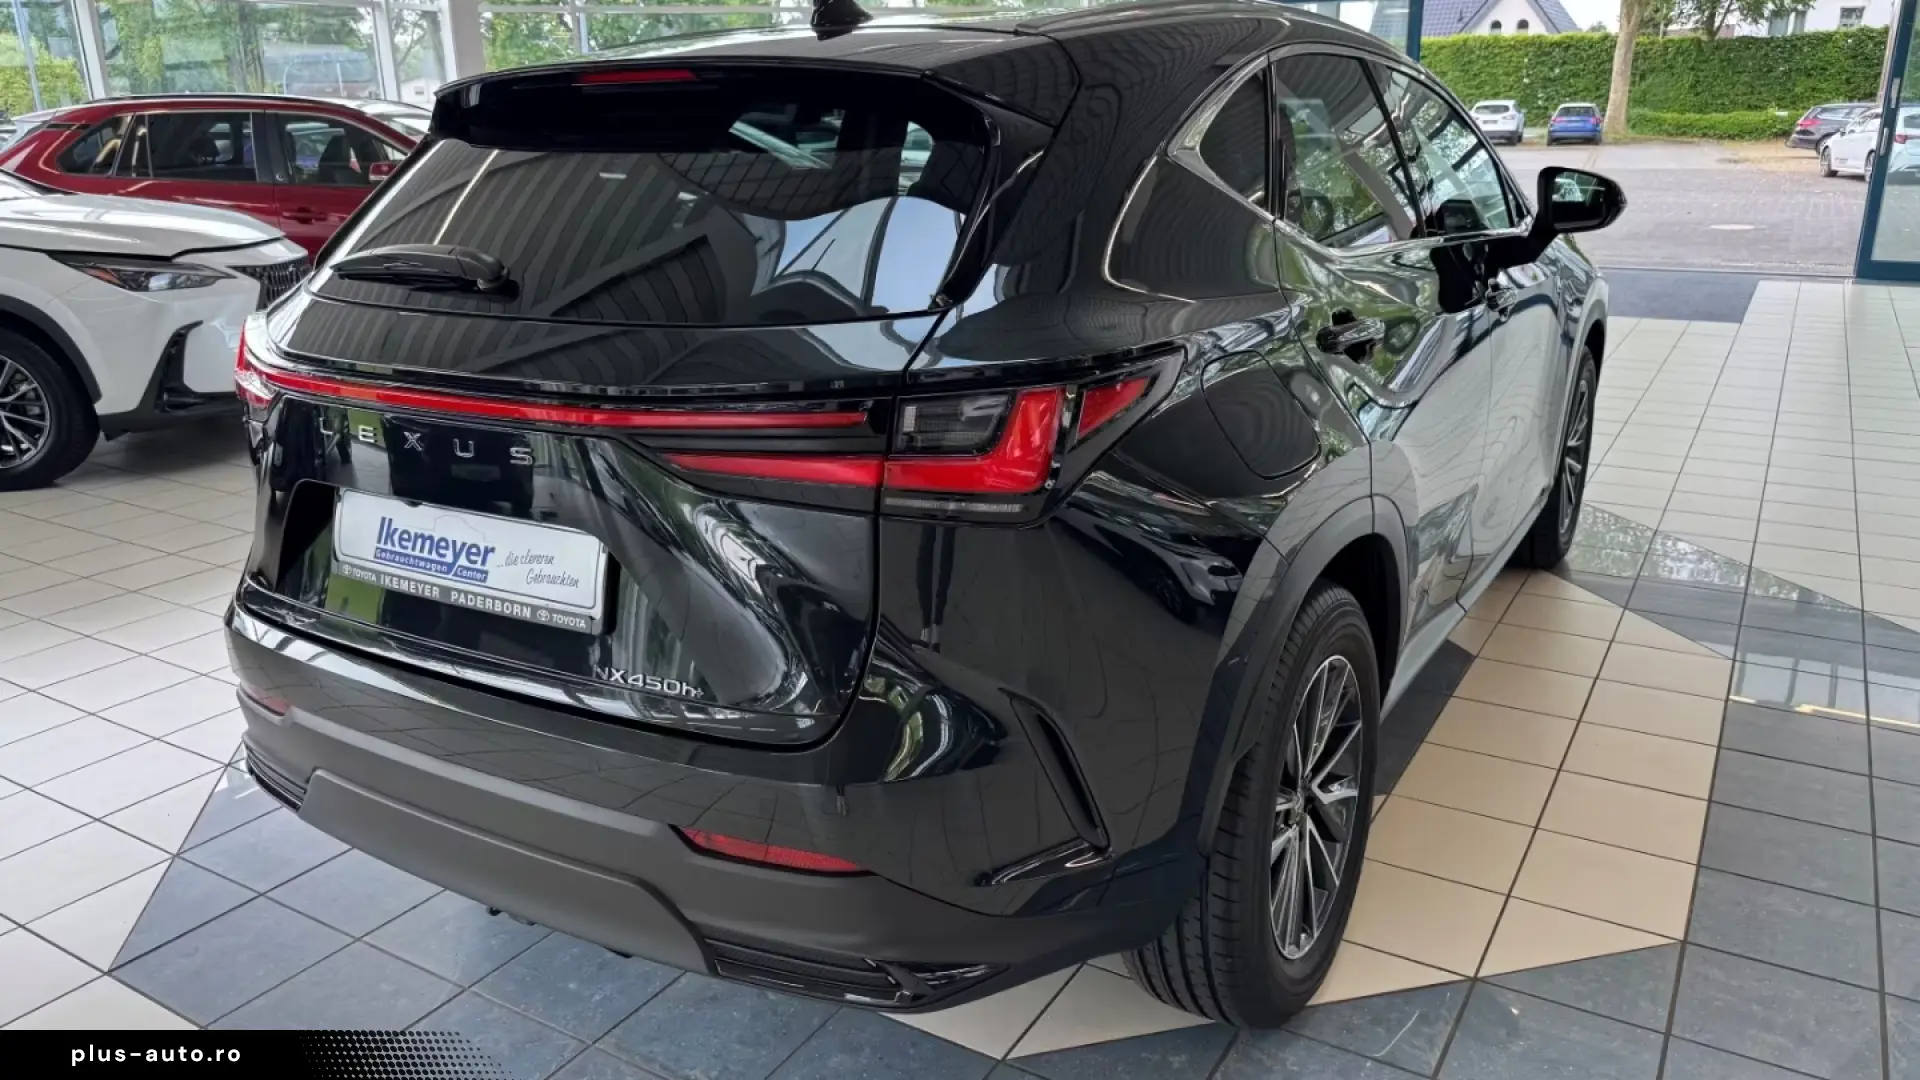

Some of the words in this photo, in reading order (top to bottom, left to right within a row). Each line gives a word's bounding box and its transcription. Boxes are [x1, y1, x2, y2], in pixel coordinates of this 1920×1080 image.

[319, 416, 533, 465] LEXUS
[375, 549, 448, 573] Gebrauchtwagen
[456, 567, 487, 581] Center
[376, 516, 496, 571] Ikemeyer
[352, 567, 377, 582] TOYOTA
[380, 574, 440, 599] IKEMEYER
[451, 591, 532, 618] PADERBORN
[552, 614, 586, 629] TOYOTA
